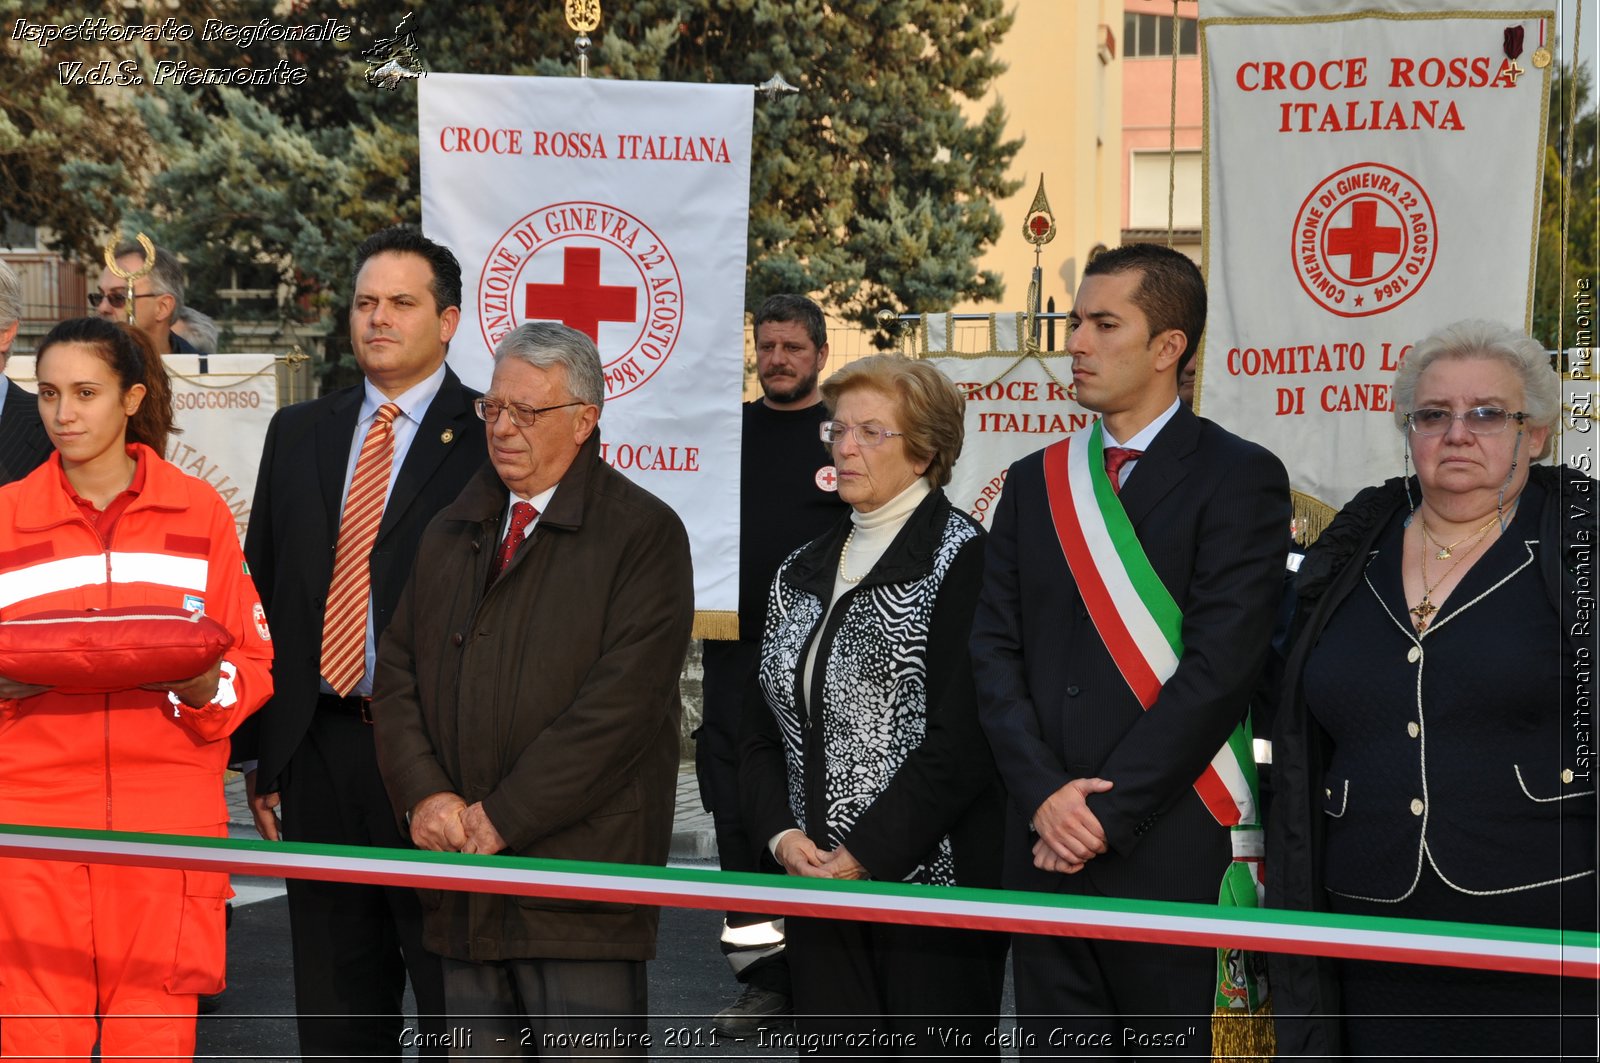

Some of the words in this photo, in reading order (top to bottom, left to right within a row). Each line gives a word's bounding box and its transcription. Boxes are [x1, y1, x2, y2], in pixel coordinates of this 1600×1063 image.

[1235, 57, 1368, 92] CROCE
[1388, 56, 1517, 89] ROSSA
[1278, 100, 1465, 132] ITALIANA
[439, 126, 522, 155] CROCE
[533, 131, 608, 160] ROSSA
[617, 135, 731, 163] ITALIANA
[1318, 189, 1337, 208] DI
[1336, 172, 1401, 197] GINEVRA
[1398, 191, 1418, 211] 22
[513, 221, 543, 251] DI
[545, 207, 641, 250] GINEVRA
[1405, 212, 1428, 275] AGOSTO
[638, 244, 666, 271] 22
[1302, 206, 1346, 304] CONVENZIONE
[1373, 275, 1409, 302] 1864
[640, 277, 678, 360] AGOSTO
[1227, 342, 1366, 376] COMITATO
[604, 356, 645, 394] 1864
[176, 391, 260, 410] SOCCORSO
[1275, 386, 1305, 415] DI
[979, 413, 1099, 433] ITALIAN
[600, 443, 699, 471] LOCALE
